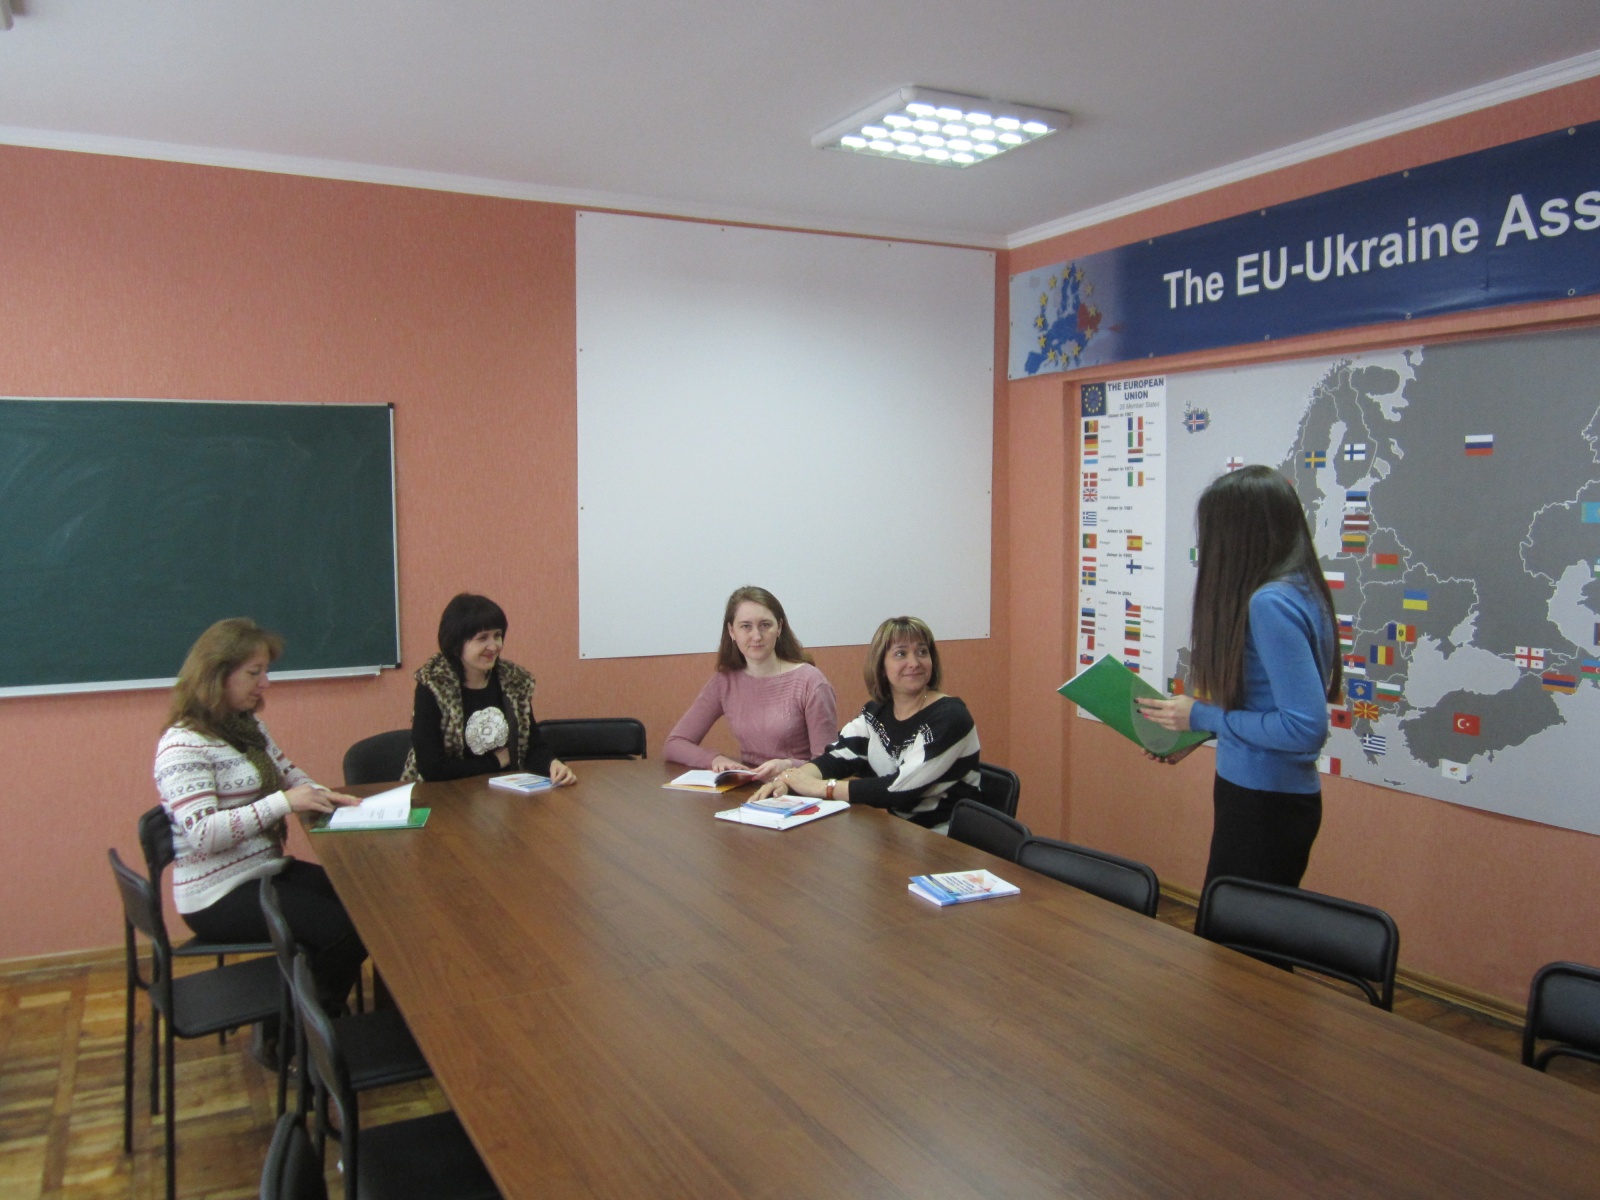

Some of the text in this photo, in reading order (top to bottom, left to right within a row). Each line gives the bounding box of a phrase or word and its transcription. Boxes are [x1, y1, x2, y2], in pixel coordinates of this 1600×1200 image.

[1163, 190, 1600, 309] The EU-Ukraine Ass
[1108, 378, 1164, 392] THE EUROPEAN
[1124, 390, 1149, 401] UNION
[1126, 402, 1145, 410] Member
